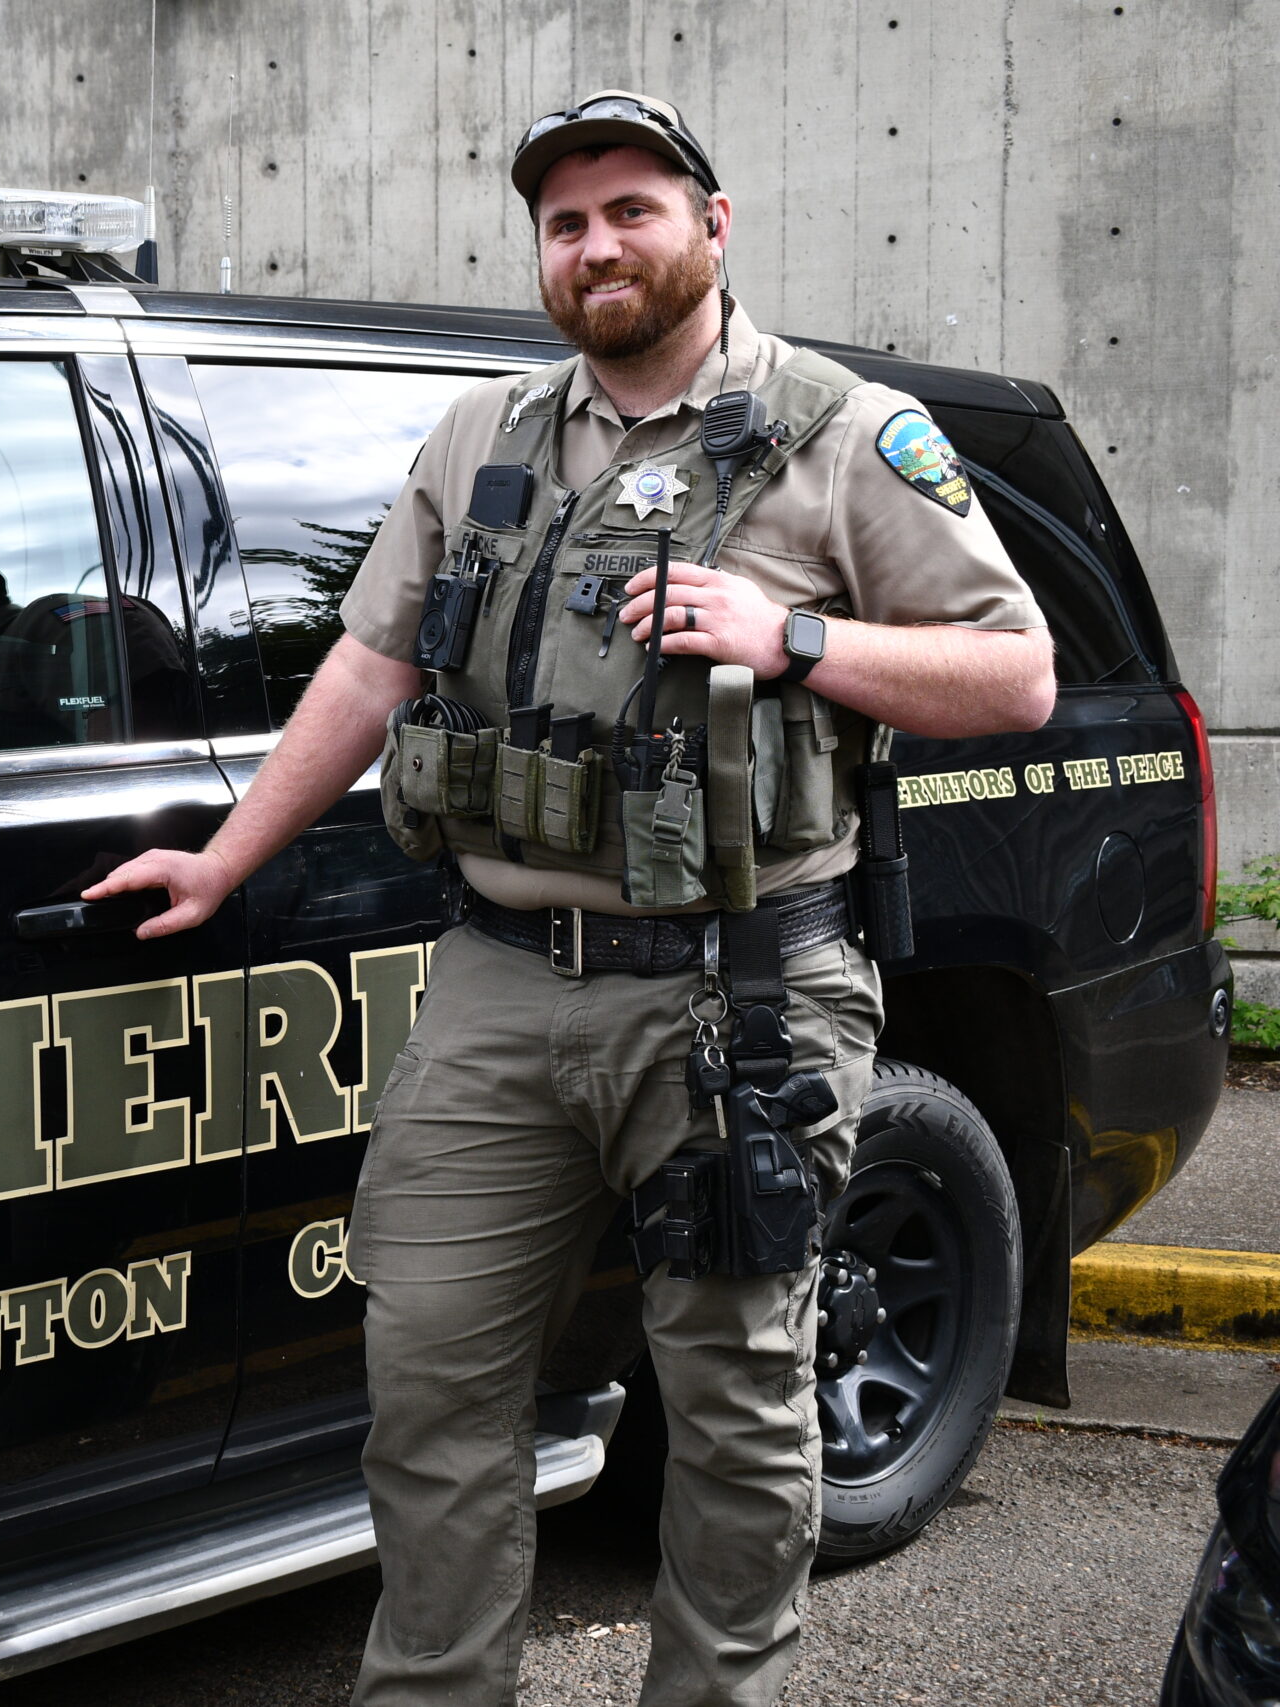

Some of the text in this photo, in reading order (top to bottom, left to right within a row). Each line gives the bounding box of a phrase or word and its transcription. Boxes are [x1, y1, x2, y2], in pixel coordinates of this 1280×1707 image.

[880, 417, 909, 449] BENTON
[584, 553, 657, 573] SHERIF
[59, 696, 105, 706] FLEXFUEL
[1024, 763, 1054, 794] OF
[1063, 758, 1112, 790] THE
[1117, 751, 1185, 785] PEACE
